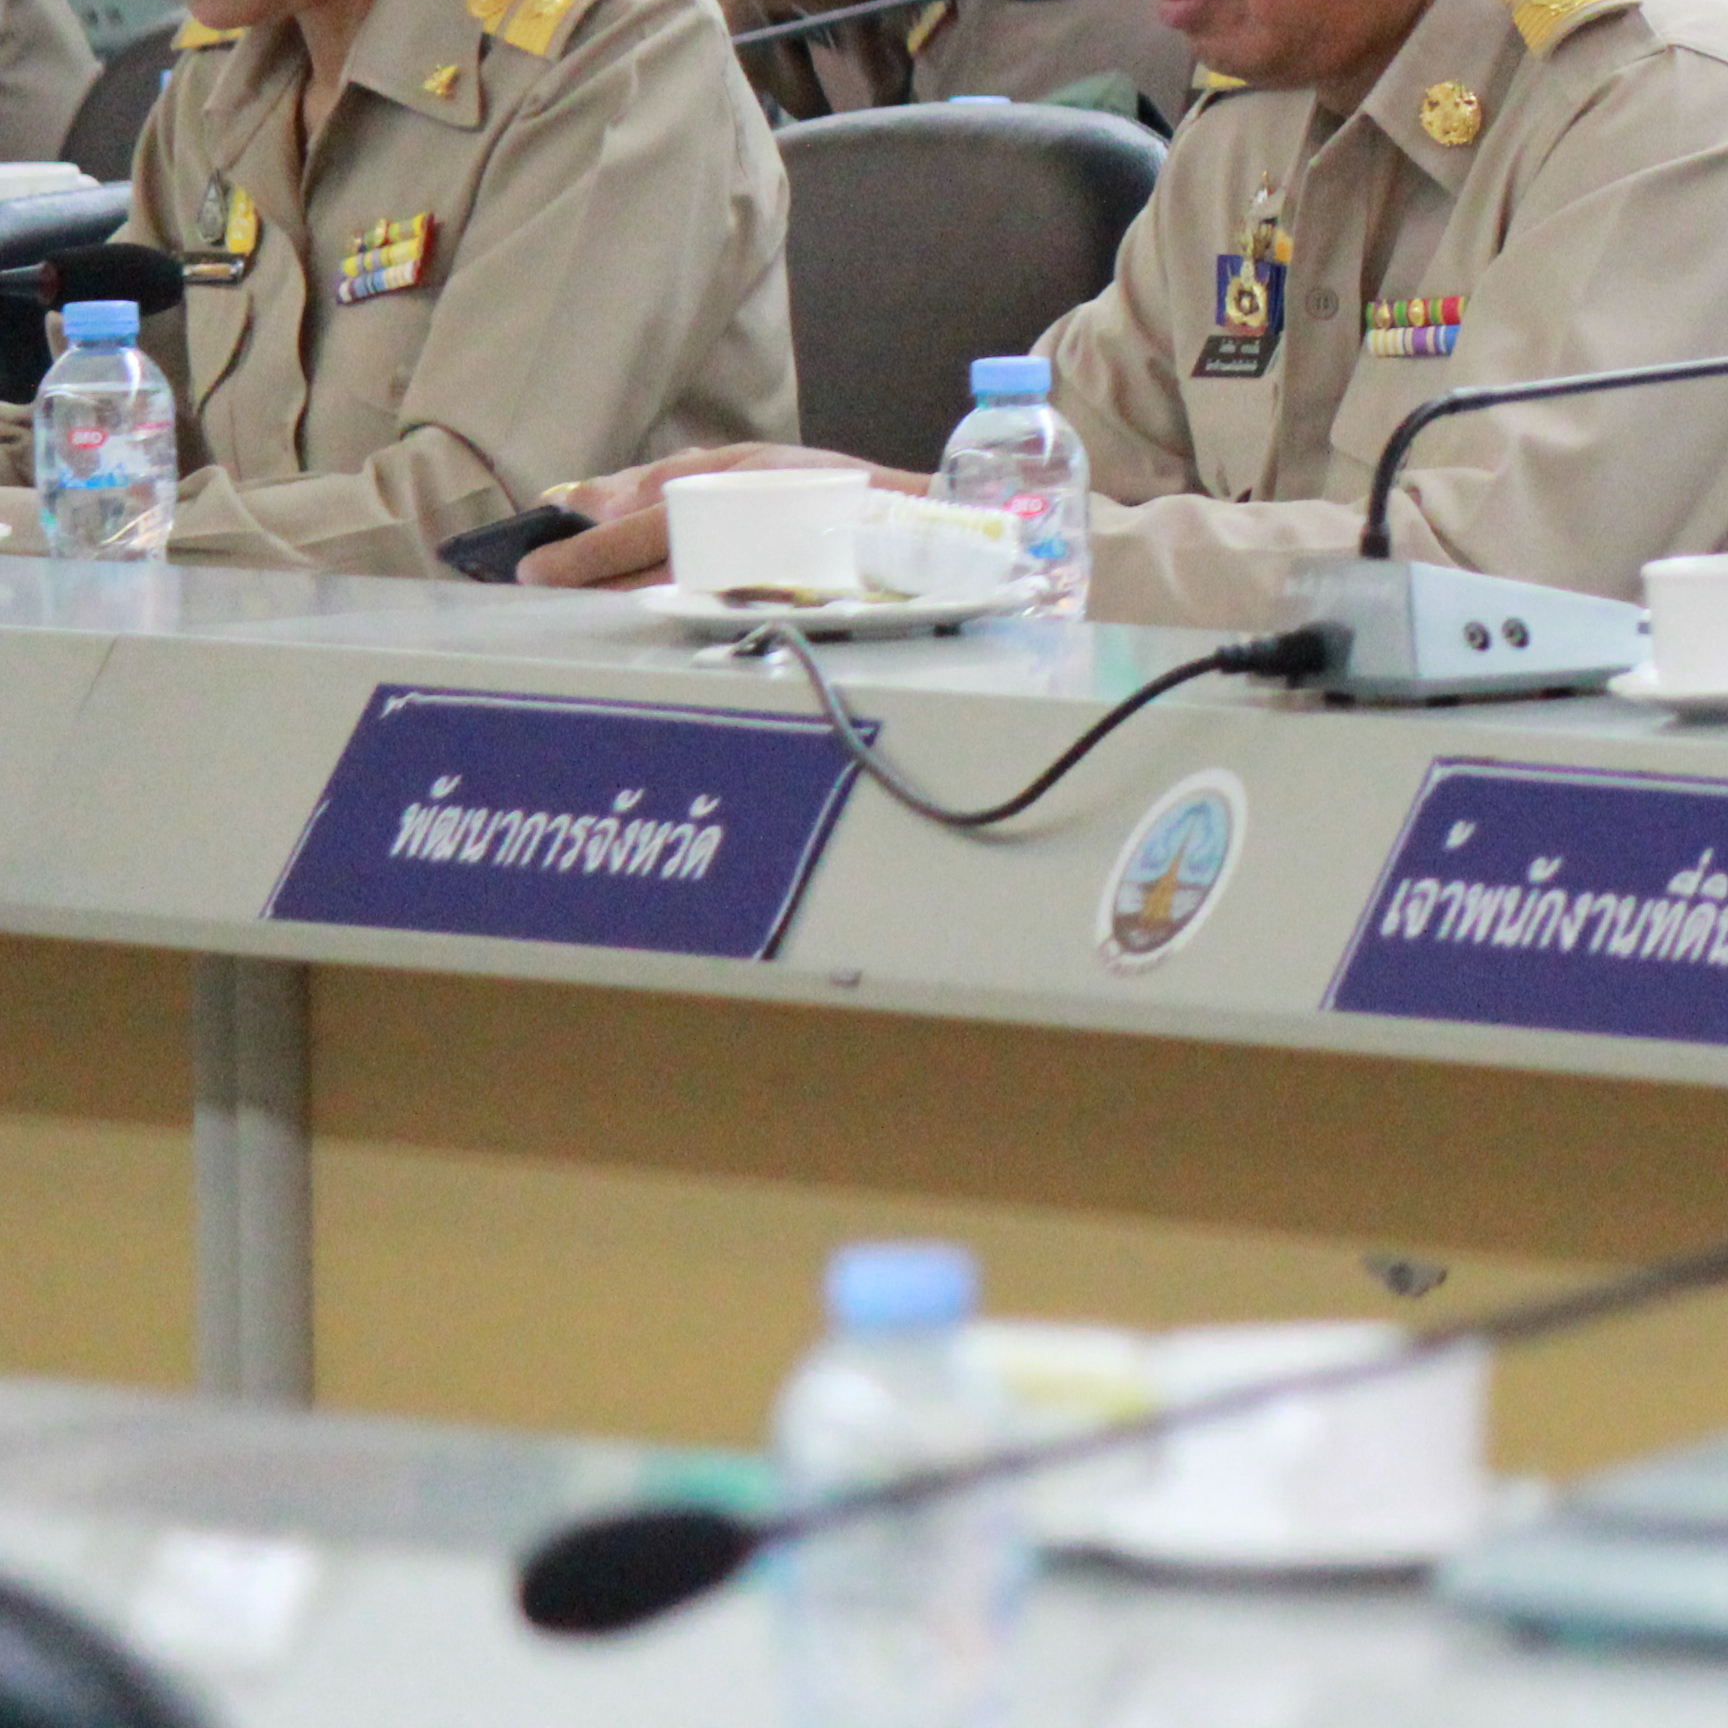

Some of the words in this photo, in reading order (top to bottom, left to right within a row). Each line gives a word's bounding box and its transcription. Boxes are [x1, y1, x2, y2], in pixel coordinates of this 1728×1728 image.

[390, 774, 724, 880] พัฒนาการจังหวัด
